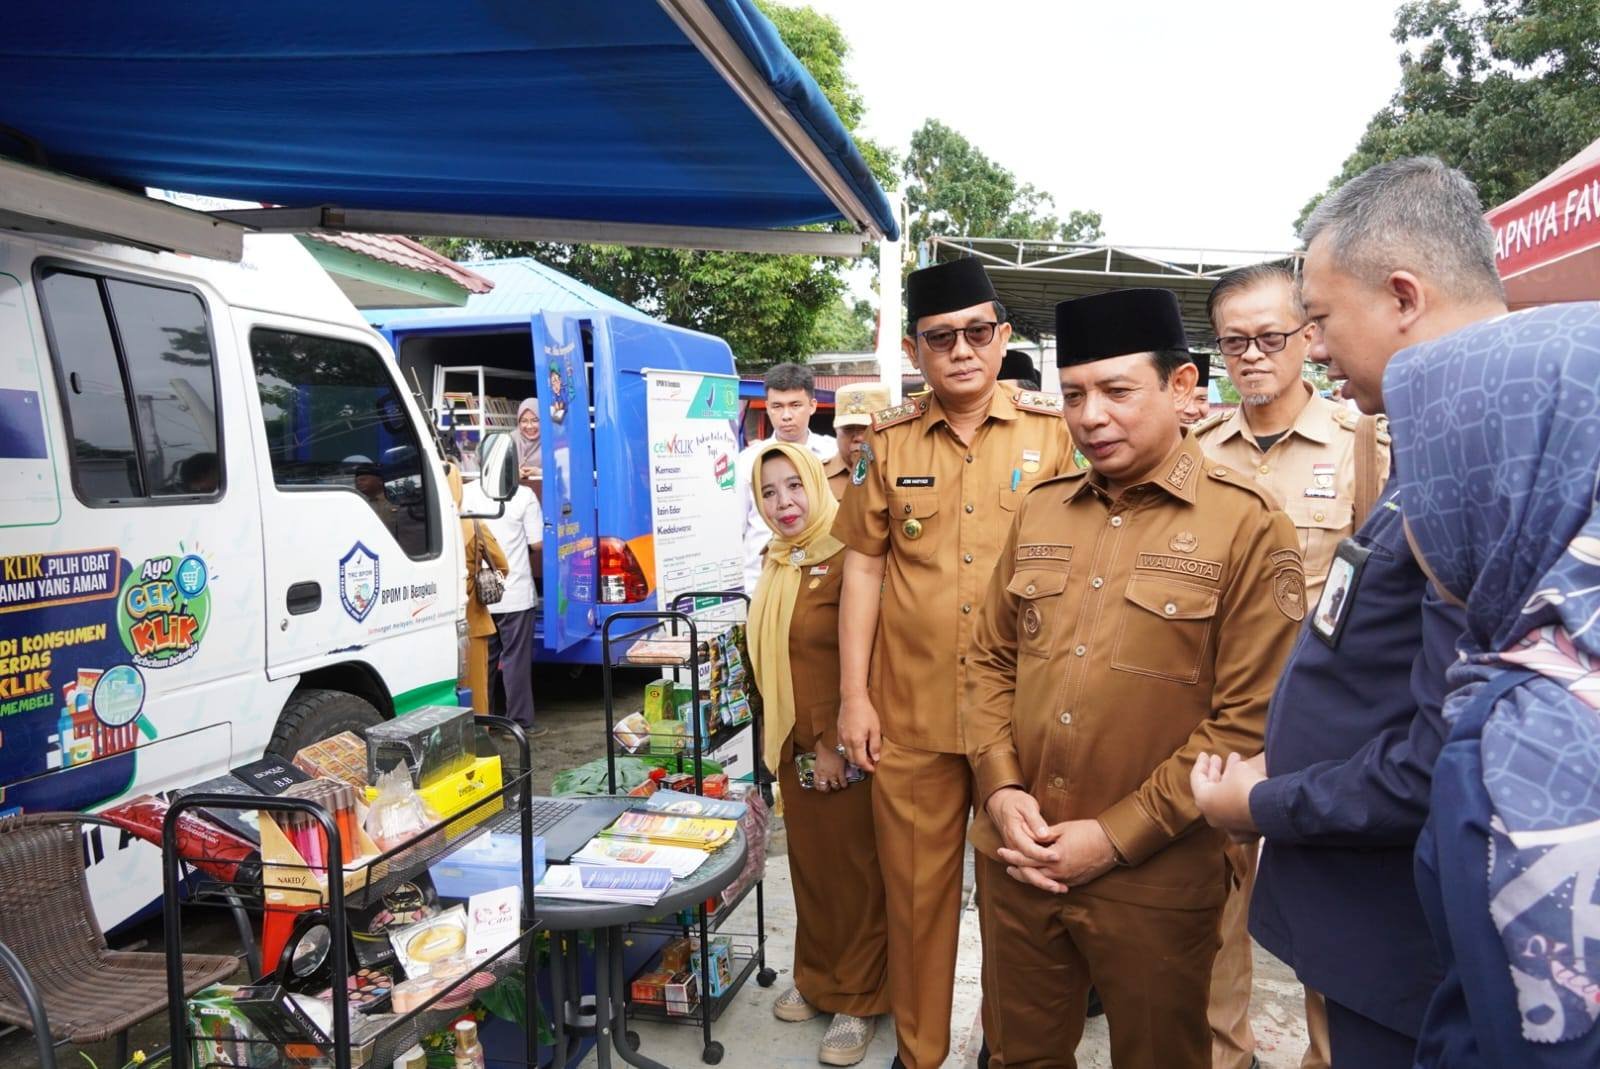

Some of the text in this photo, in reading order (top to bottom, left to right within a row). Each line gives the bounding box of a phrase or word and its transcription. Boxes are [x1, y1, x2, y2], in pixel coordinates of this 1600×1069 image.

[1494, 201, 1558, 260] APNYA
[656, 483, 672, 493] Label
[4, 554, 43, 580] KLIK
[82, 553, 110, 572] OBAT
[141, 557, 172, 580] Ayo
[1140, 554, 1215, 576] WALIKOTA
[38, 577, 70, 597] YANG
[73, 573, 107, 593] AMAN
[126, 580, 177, 618] CEK
[22, 624, 107, 651] KONSUMEN
